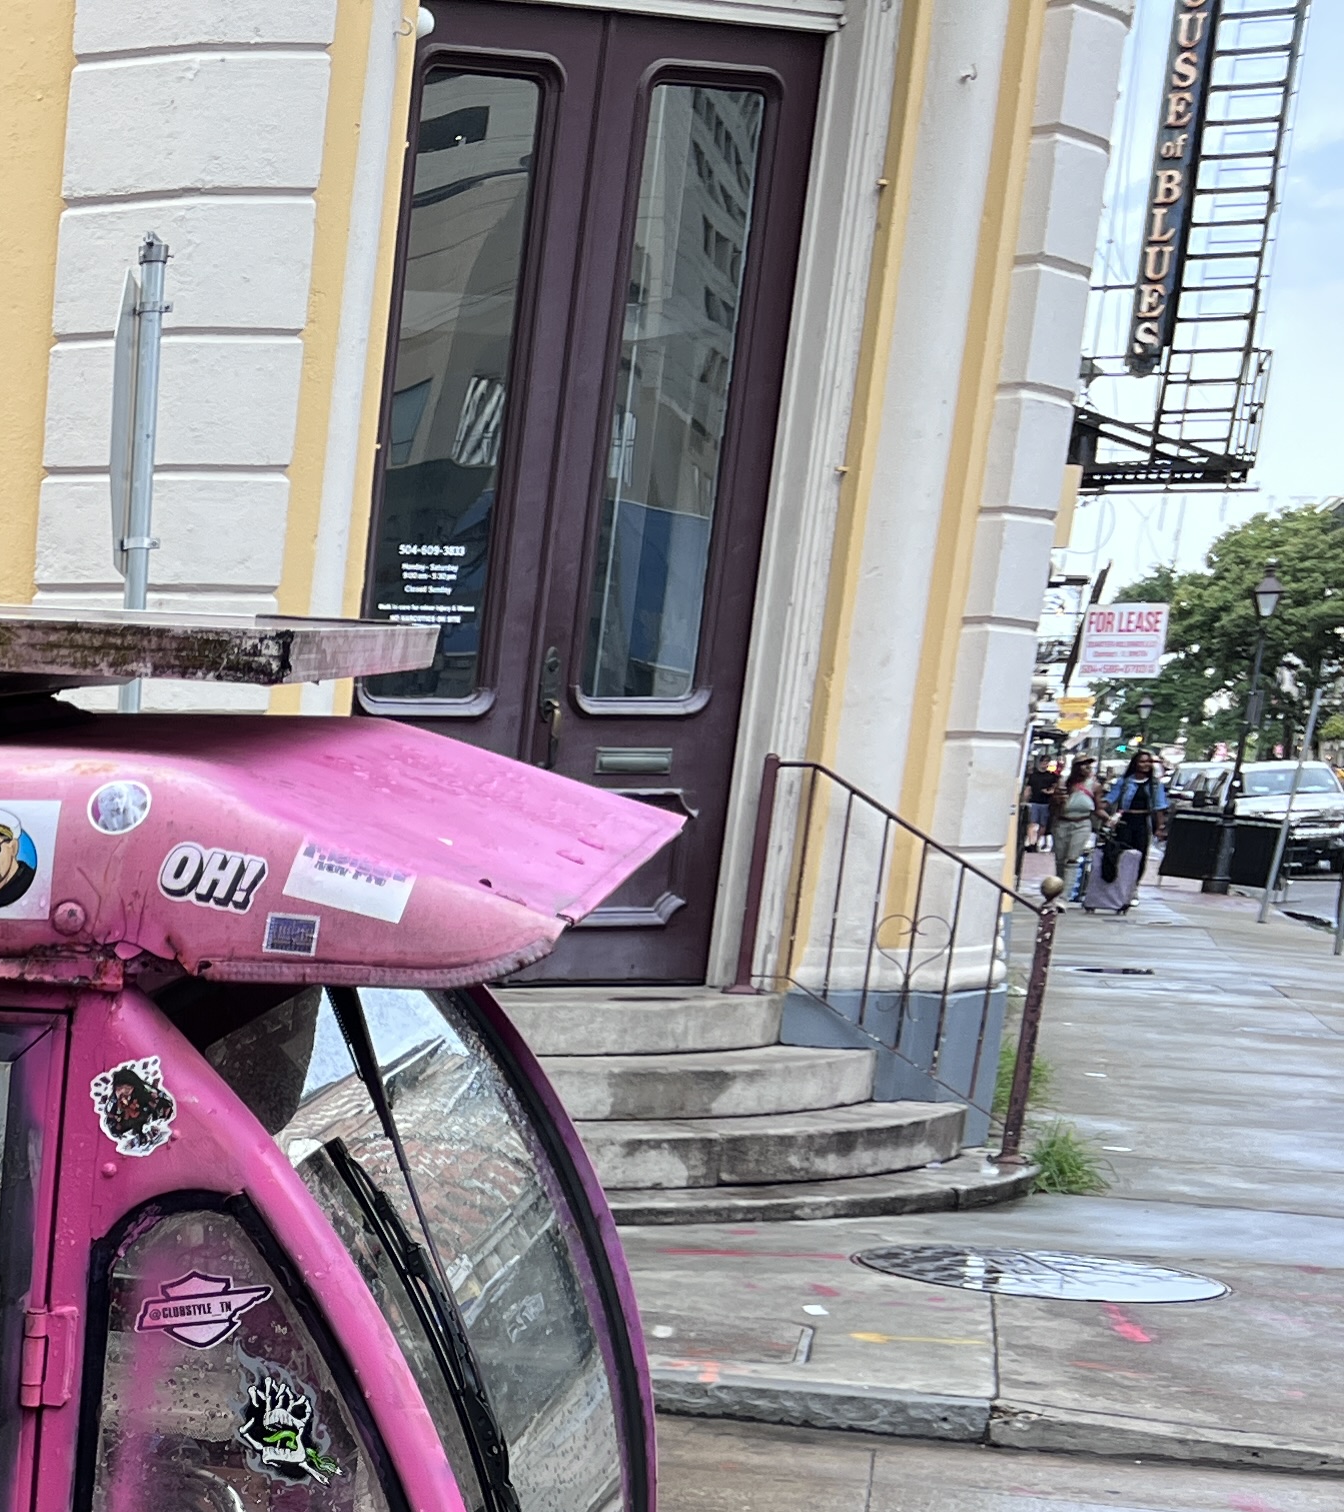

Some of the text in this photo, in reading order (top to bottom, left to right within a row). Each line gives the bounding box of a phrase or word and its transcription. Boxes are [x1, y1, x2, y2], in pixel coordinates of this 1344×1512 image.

[1087, 611, 1163, 633] FOR LEASE
[160, 845, 266, 911] OH!
